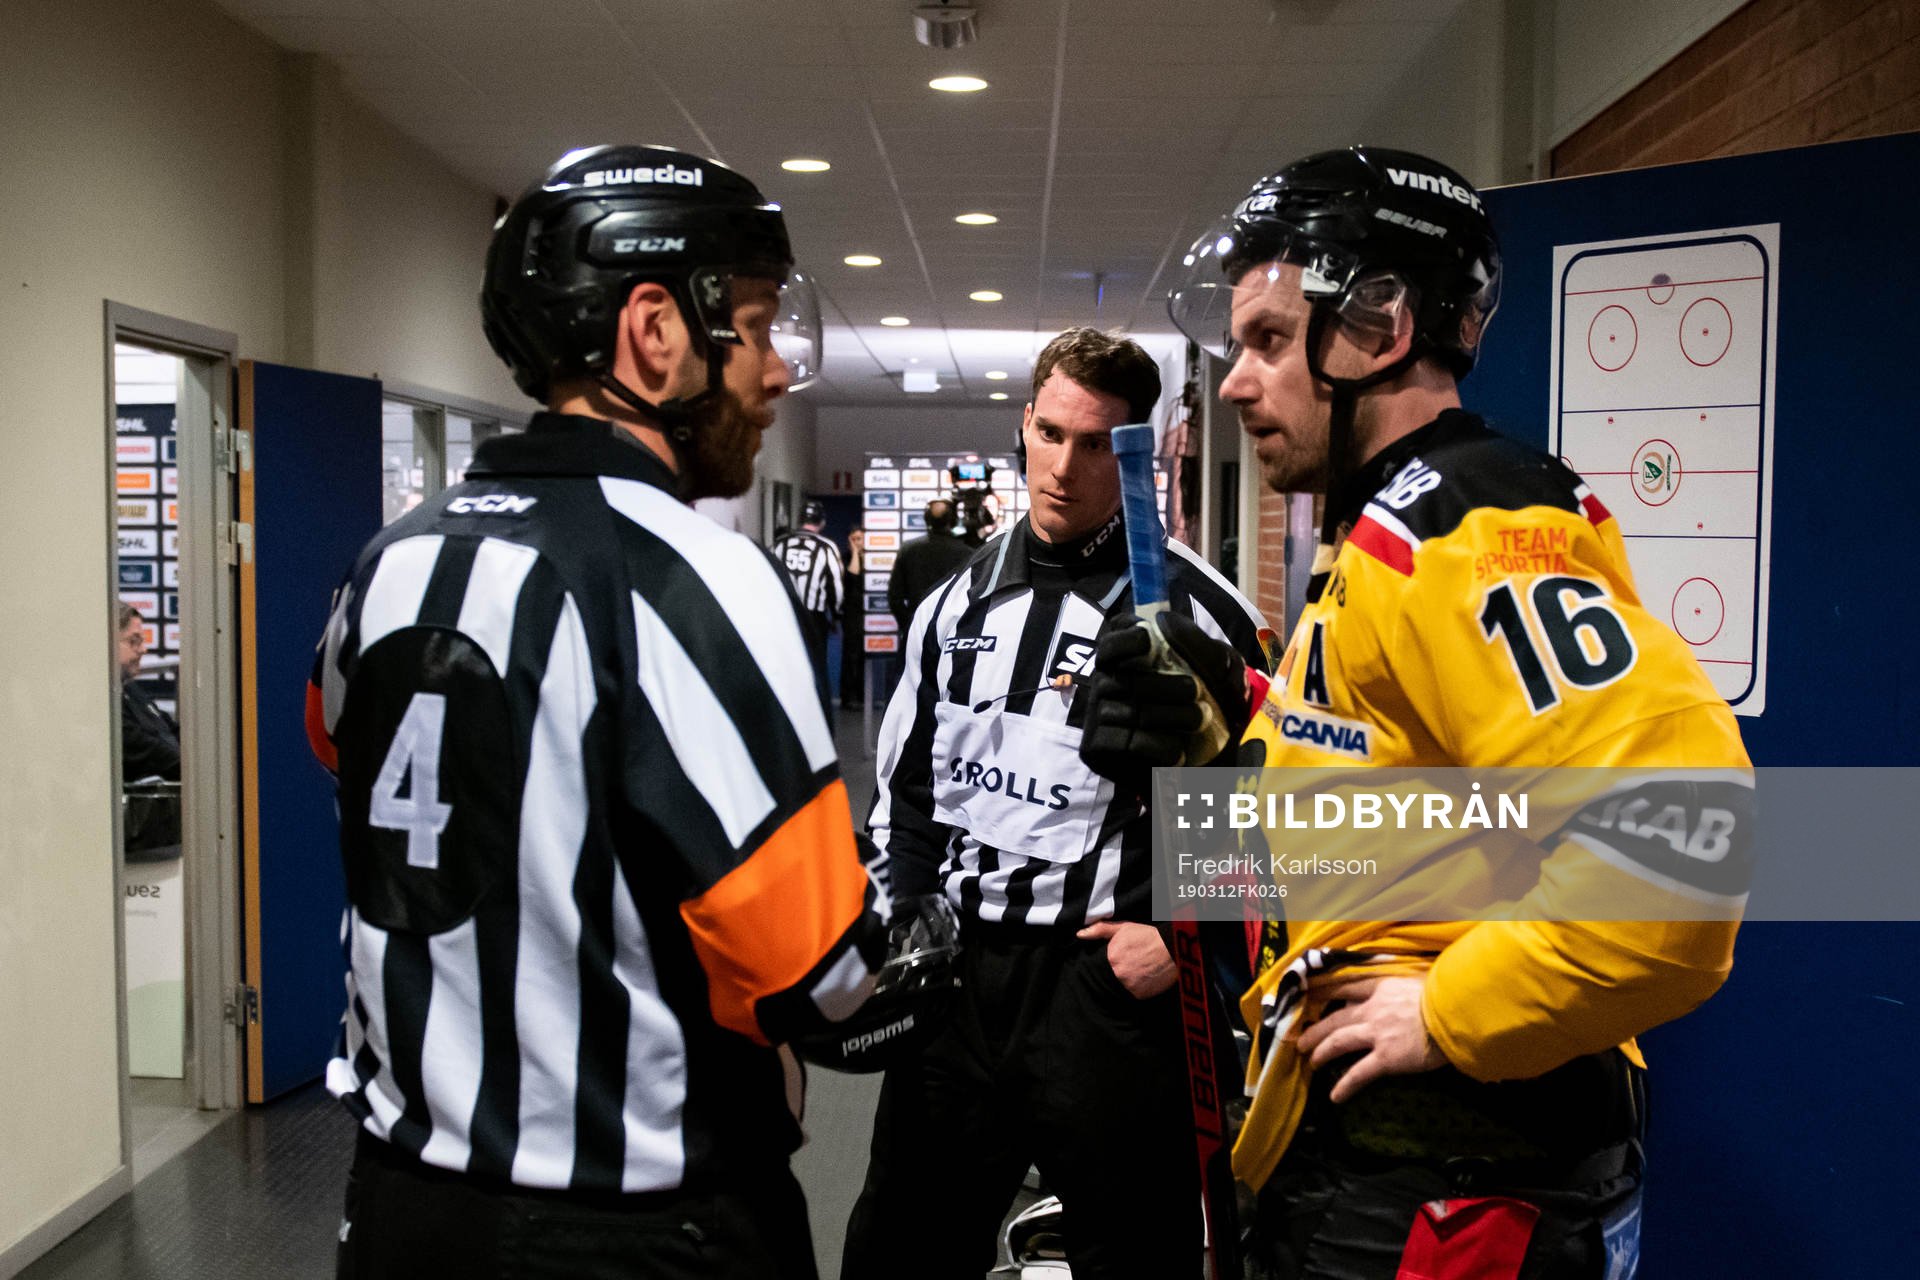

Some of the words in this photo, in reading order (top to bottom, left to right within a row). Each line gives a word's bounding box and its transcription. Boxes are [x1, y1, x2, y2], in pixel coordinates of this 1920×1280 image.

[584, 165, 703, 187] swedol
[613, 237, 687, 253] CCM
[446, 494, 538, 514] CCM
[1081, 515, 1121, 557] CCM
[1497, 527, 1568, 553] TEAM
[786, 548, 811, 572] 55
[945, 638, 996, 650] CCM
[1477, 573, 1638, 717] 16
[1303, 621, 1331, 706] A
[1281, 715, 1369, 756] CANIA
[369, 692, 453, 870] 4
[842, 1014, 915, 1057] swedol
